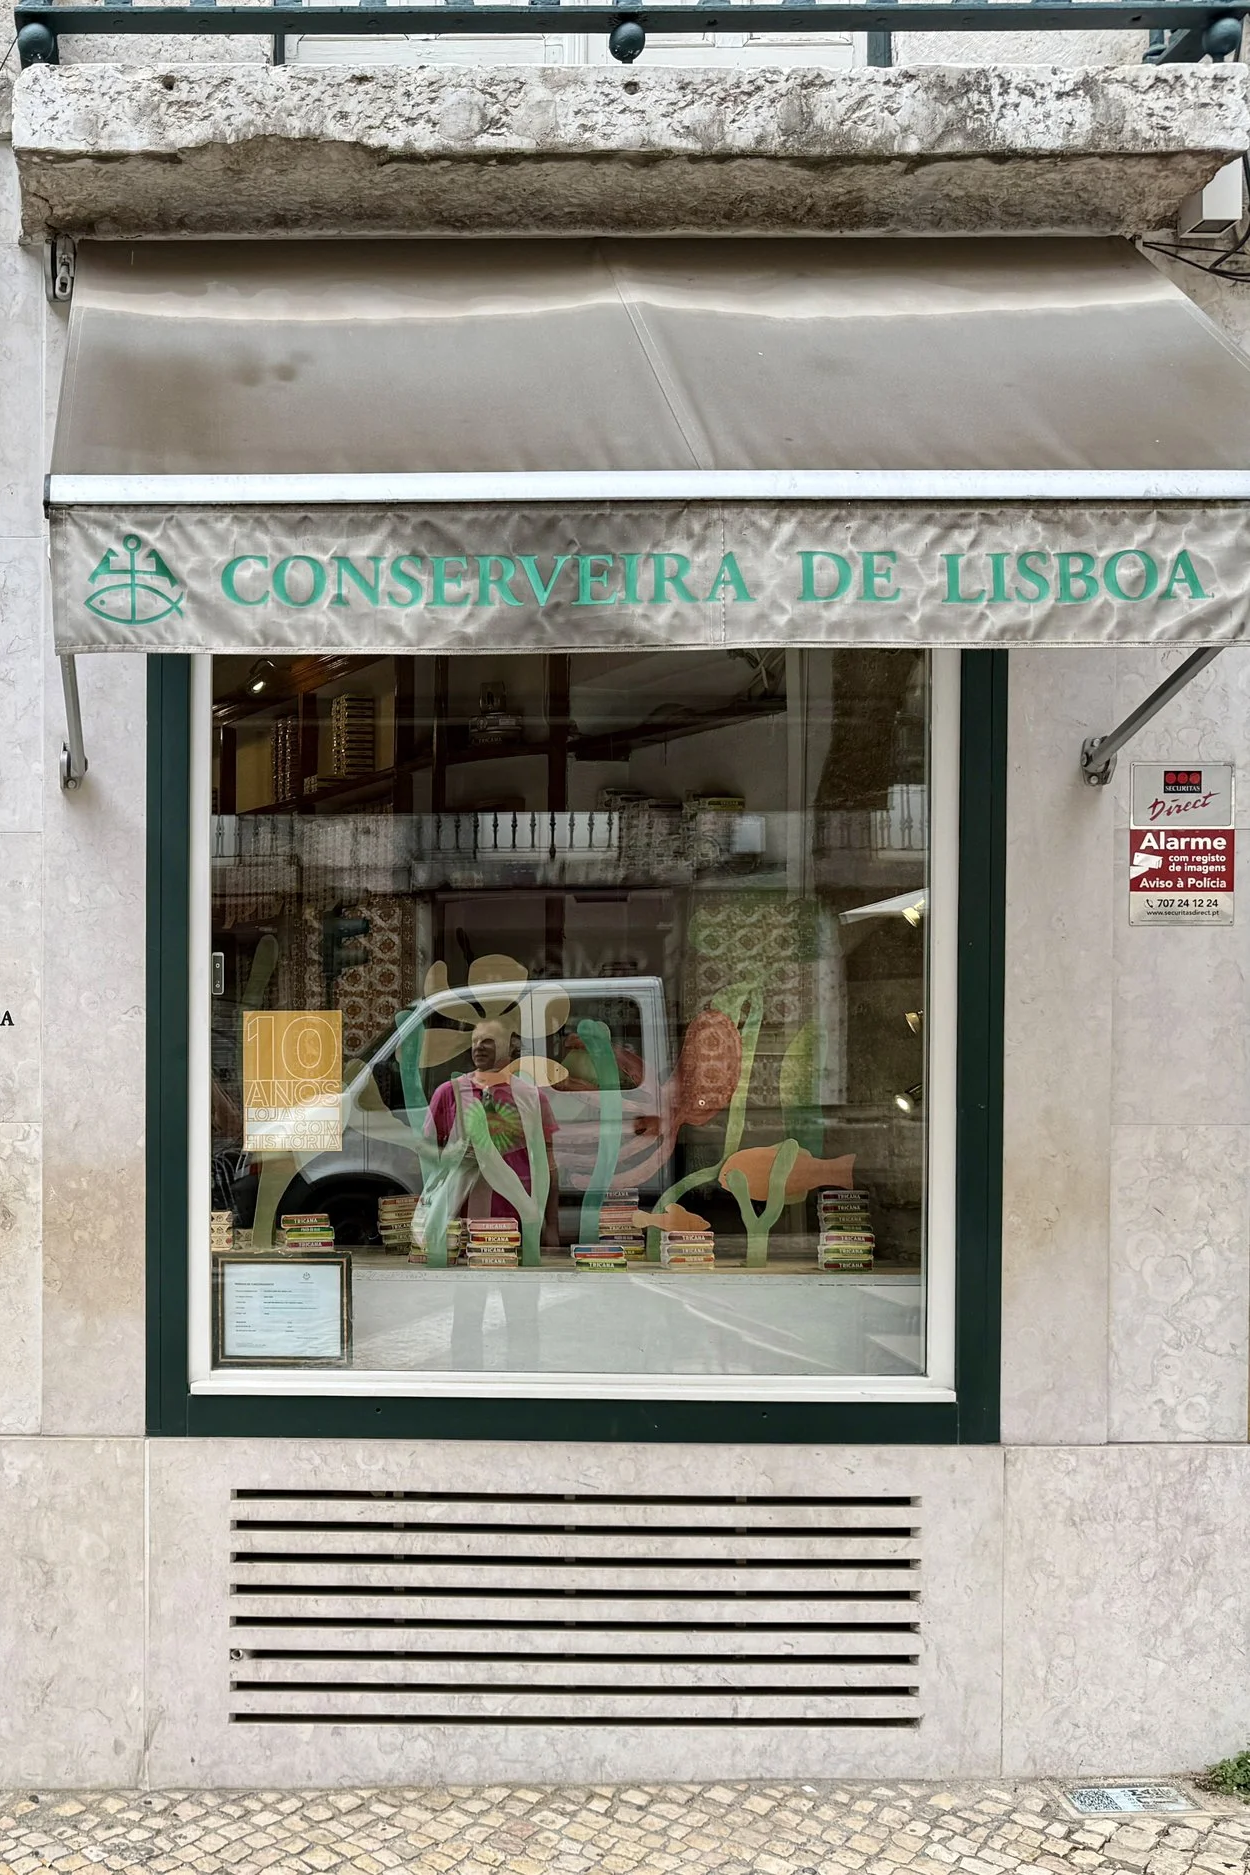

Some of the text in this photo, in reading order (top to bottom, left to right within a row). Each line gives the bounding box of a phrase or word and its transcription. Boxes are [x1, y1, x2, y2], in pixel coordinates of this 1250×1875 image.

[220, 548, 1214, 609] CONSERVEIRA DE LISBOA
[1147, 791, 1221, 821] Direct
[1139, 832, 1227, 850] Alarme
[1168, 853, 1227, 864] com registo
[1168, 863, 1227, 875] de imagens
[1139, 877, 1227, 888] Aviso à Polícia
[1157, 899, 1219, 908] 707 24 12 24
[1146, 909, 1219, 917] www.securitasdirect.pt
[247, 1015, 338, 1081] 10
[245, 1080, 340, 1107] ANOS
[246, 1107, 306, 1122] LOJAS
[293, 1120, 340, 1135] COM
